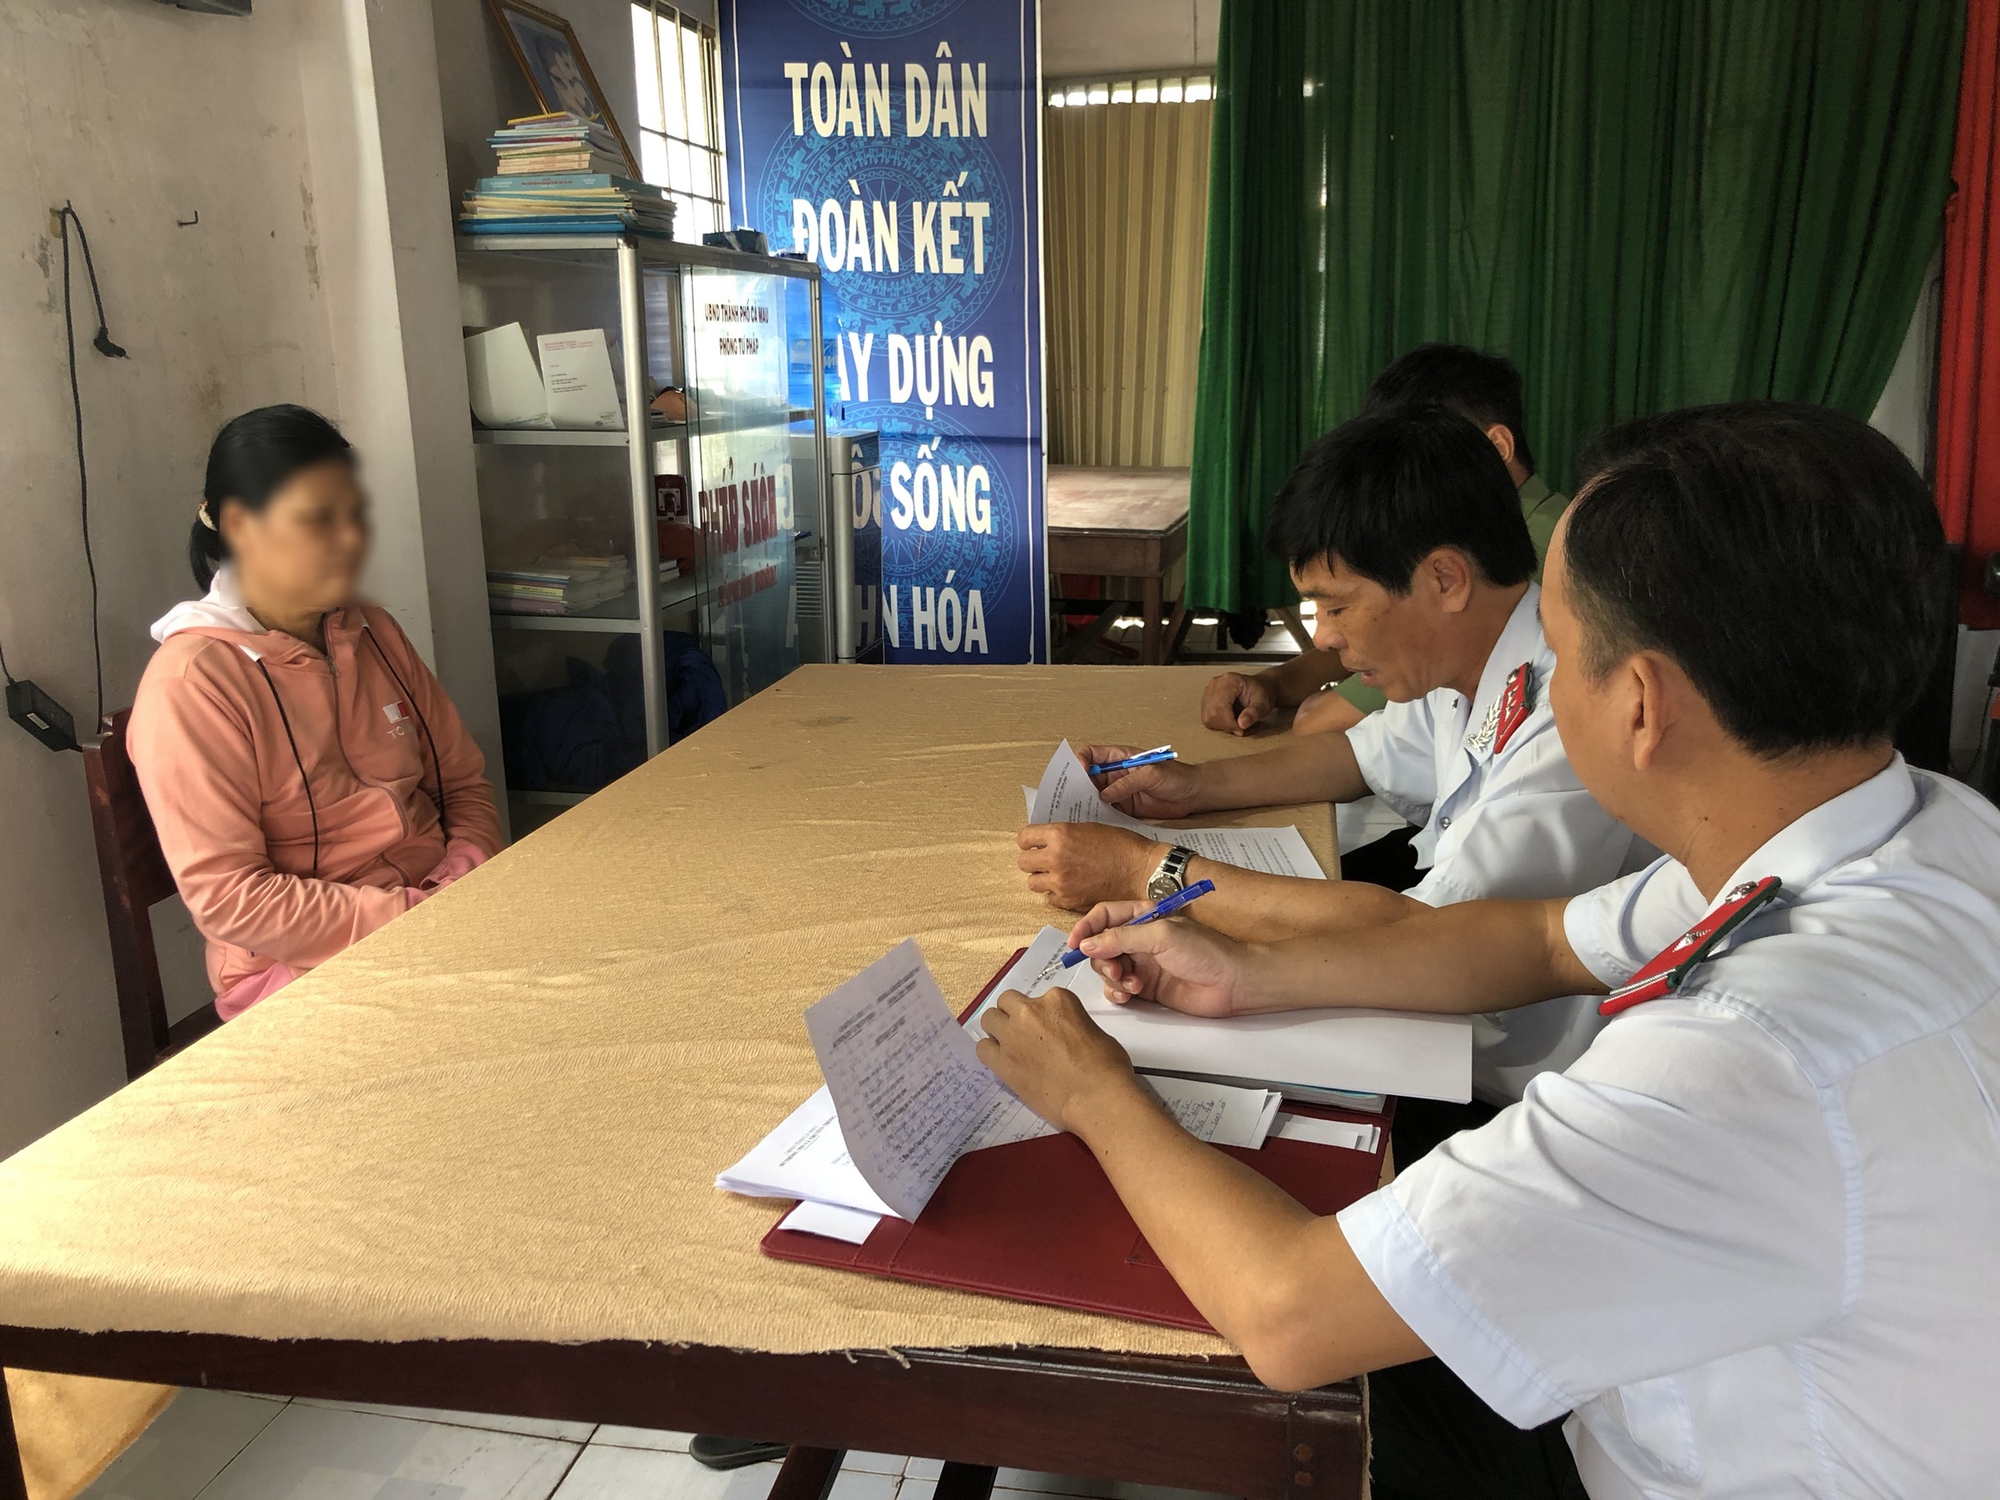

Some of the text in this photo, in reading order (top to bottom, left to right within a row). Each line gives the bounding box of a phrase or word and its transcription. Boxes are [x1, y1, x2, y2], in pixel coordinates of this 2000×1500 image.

[784, 41, 987, 138] TOÀN DÂN
[792, 171, 990, 274] ĐOÀN KẾT
[705, 303, 720, 322] UBND
[720, 299, 740, 323] THÀNH
[758, 306, 768, 324] MAU
[719, 332, 738, 356] PHÒNG
[746, 332, 760, 356] PHÁP
[888, 321, 995, 420] DỰNG
[890, 436, 992, 535] SỐNG
[912, 569, 989, 654] HÓA
